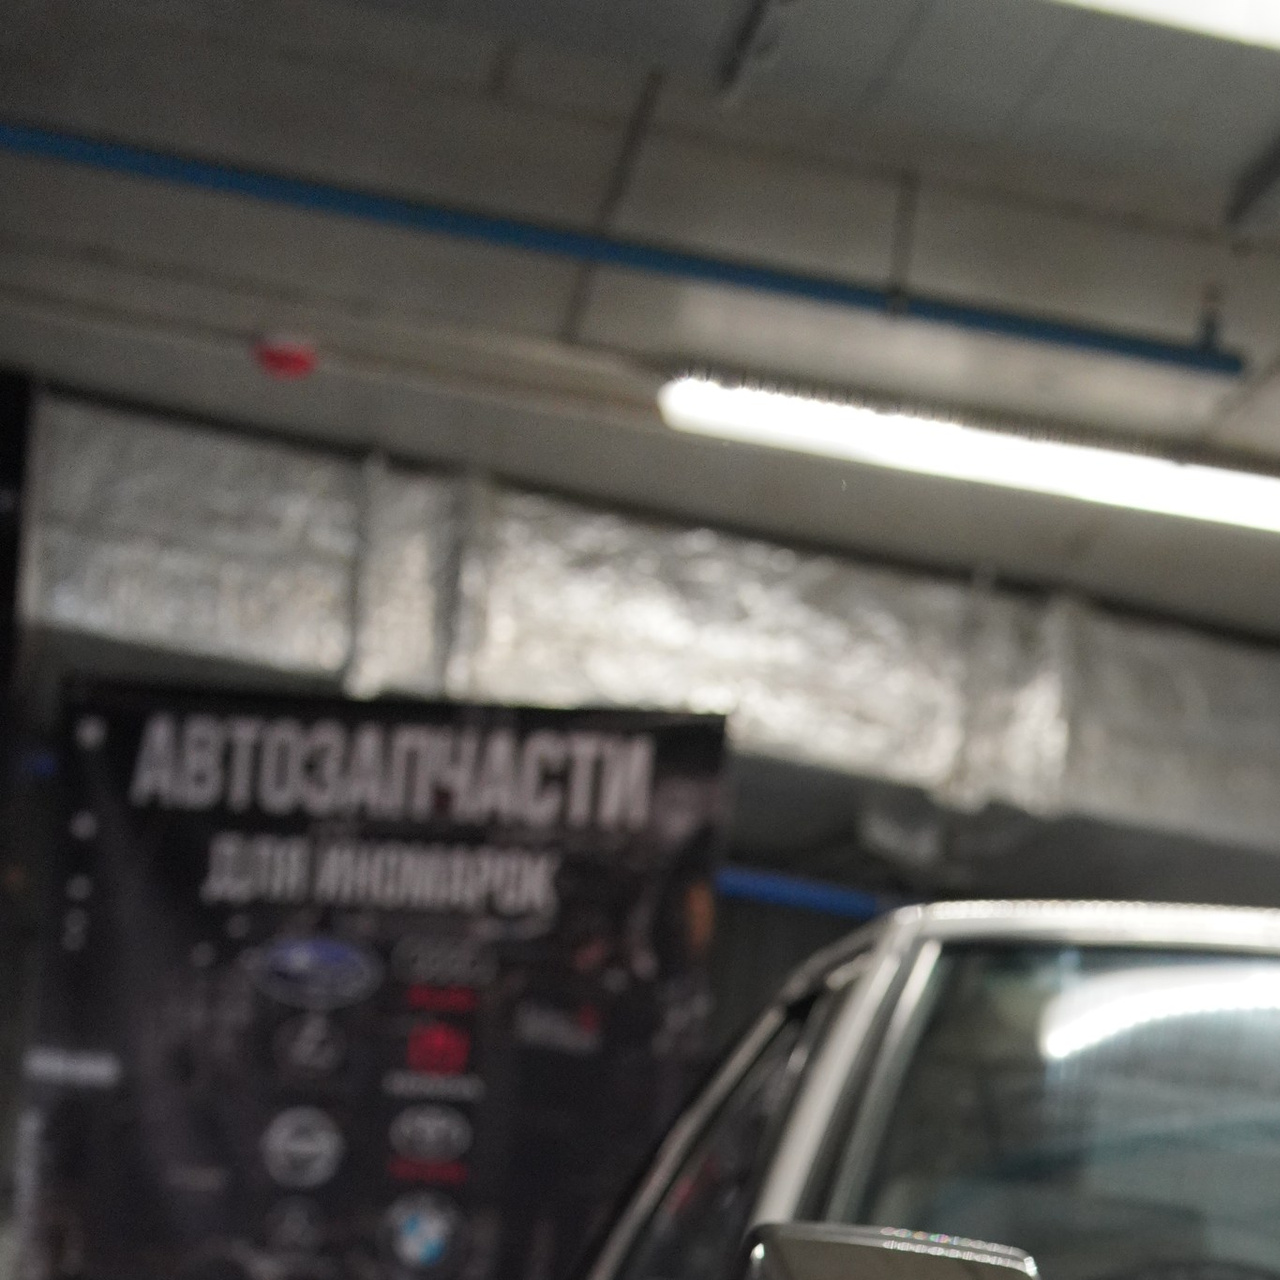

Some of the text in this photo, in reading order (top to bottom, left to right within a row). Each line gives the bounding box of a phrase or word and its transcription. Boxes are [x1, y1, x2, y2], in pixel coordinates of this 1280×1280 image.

[131, 711, 655, 830] АВТОЗАПЧАСТИ
[205, 834, 559, 913] ДЛЯ ИНОМАРОК
